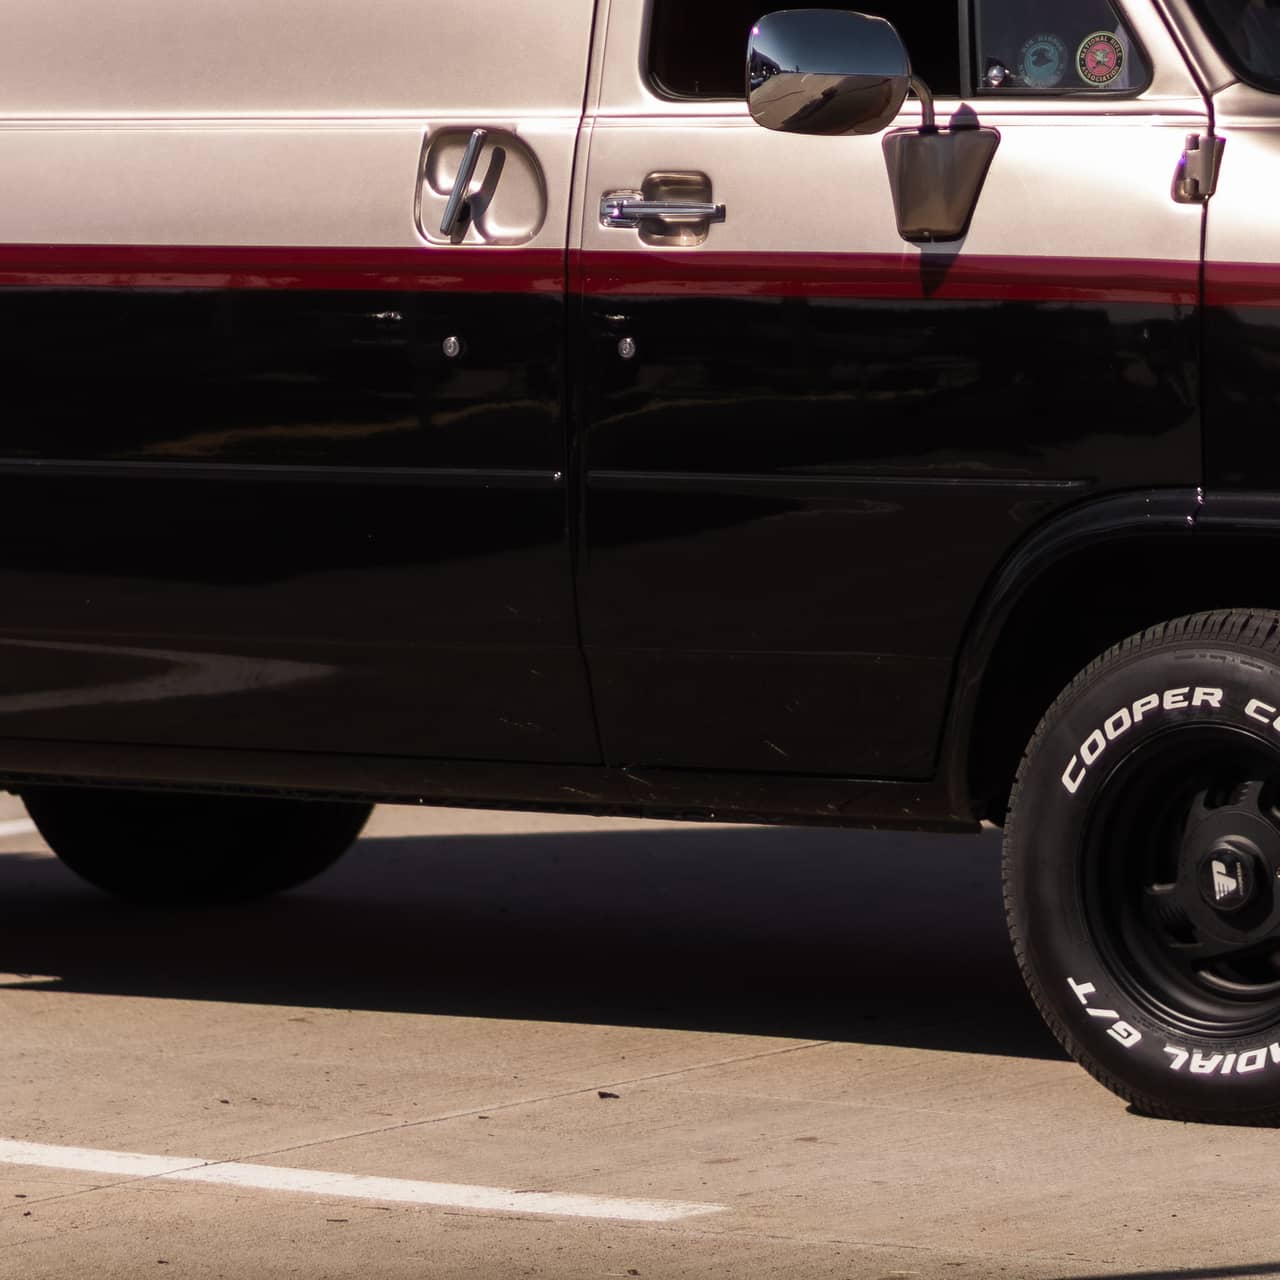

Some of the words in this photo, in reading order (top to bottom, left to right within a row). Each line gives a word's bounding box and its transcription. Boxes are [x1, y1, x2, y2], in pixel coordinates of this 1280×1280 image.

[1080, 35, 1108, 59] NATIONAL
[1110, 38, 1122, 57] RIFLE
[1082, 65, 1120, 82] ASSOCIATION
[1061, 686, 1223, 795] COOPER
[1066, 976, 1143, 1048] G/T
